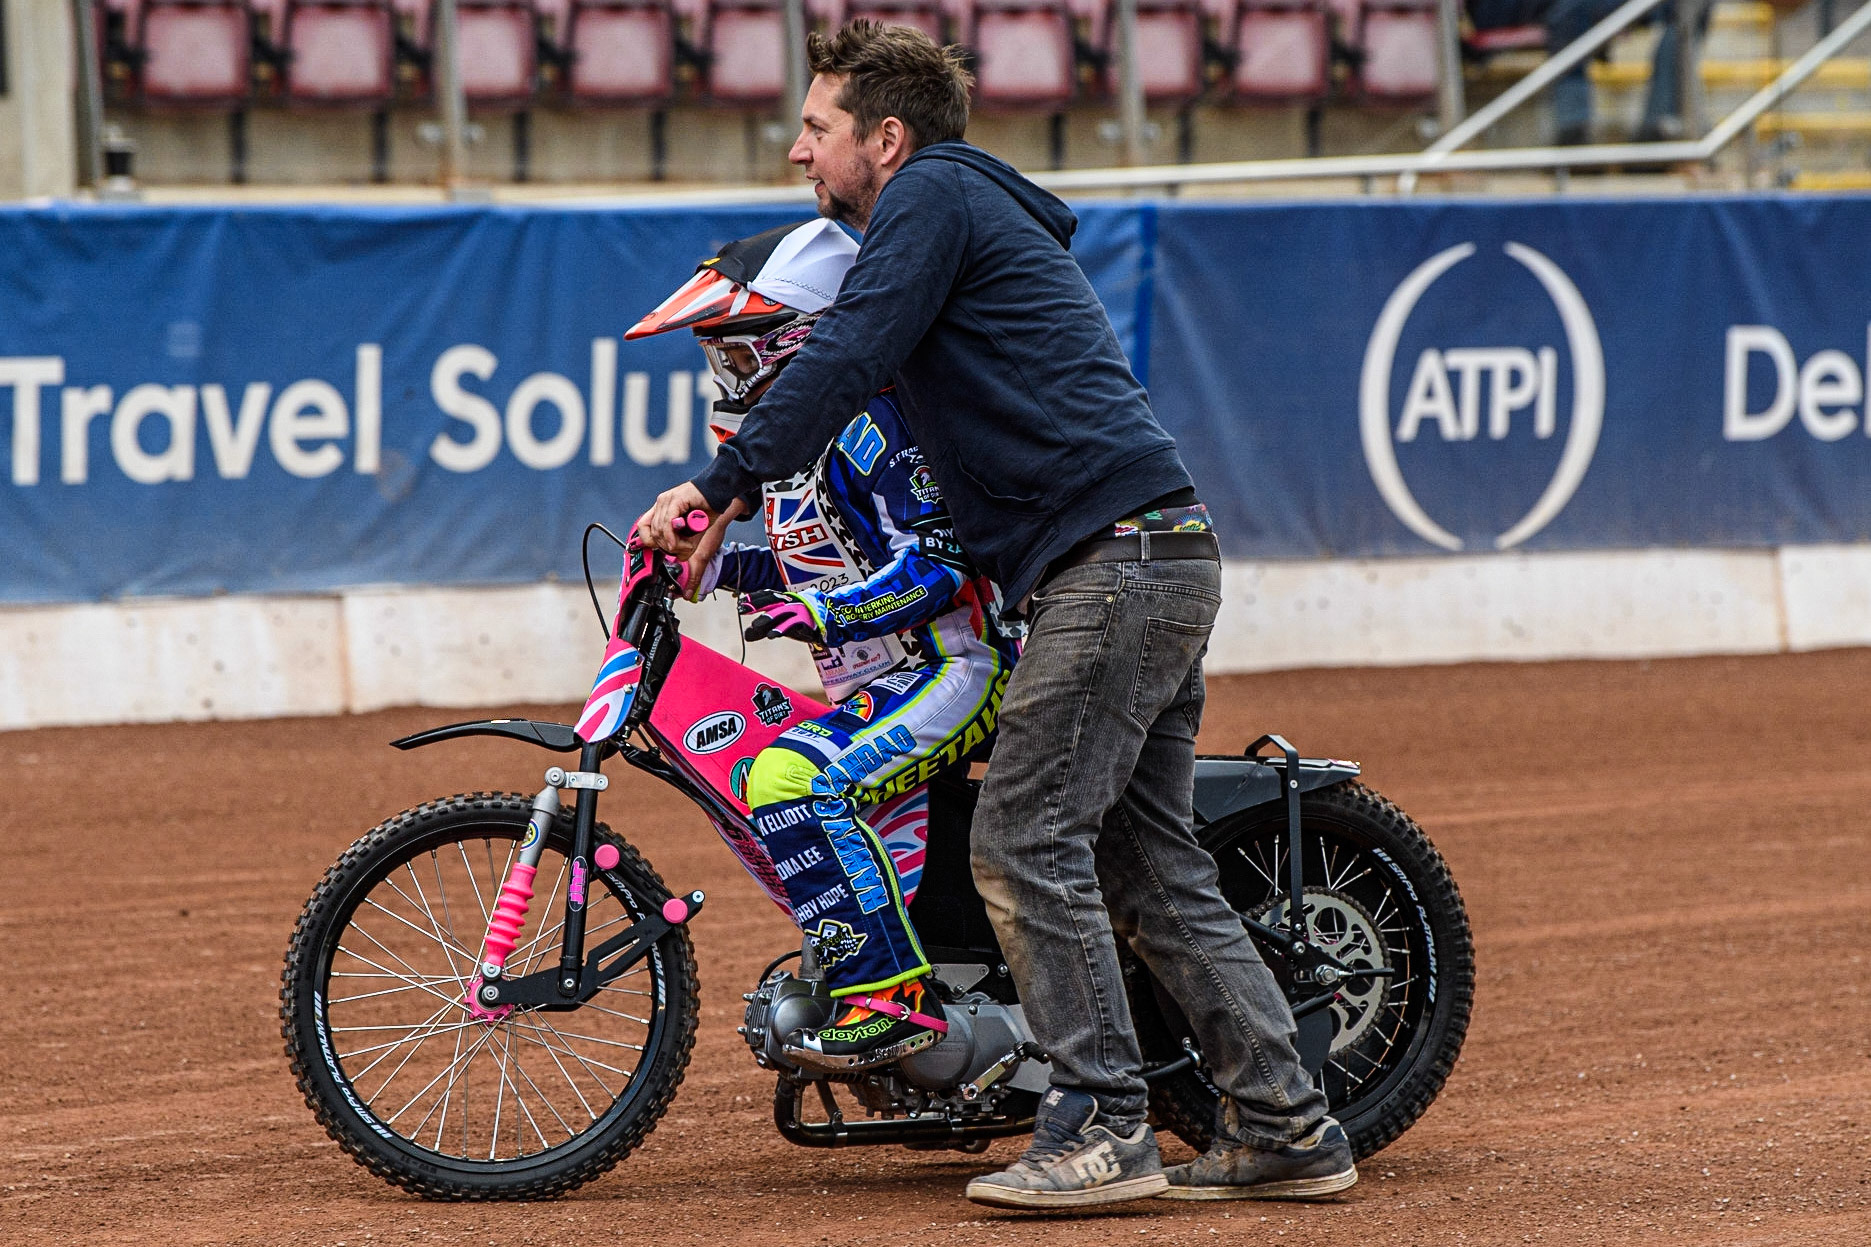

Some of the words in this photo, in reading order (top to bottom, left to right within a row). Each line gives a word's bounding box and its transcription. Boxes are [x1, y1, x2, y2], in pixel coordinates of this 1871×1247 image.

[1397, 346, 1558, 442] ATPI
[1723, 320, 1871, 442] De
[0, 344, 382, 486] Travel
[916, 486, 941, 497] TITAN
[925, 537, 944, 549] BY
[875, 588, 925, 615] MAINTENANCE
[759, 701, 790, 720] TITANS
[696, 717, 737, 749] AMSA
[765, 804, 812, 834] ELLIOTT
[797, 846, 824, 869] LEE
[816, 884, 849, 911] HOPE
[315, 1020, 344, 1084] PLATINUM
